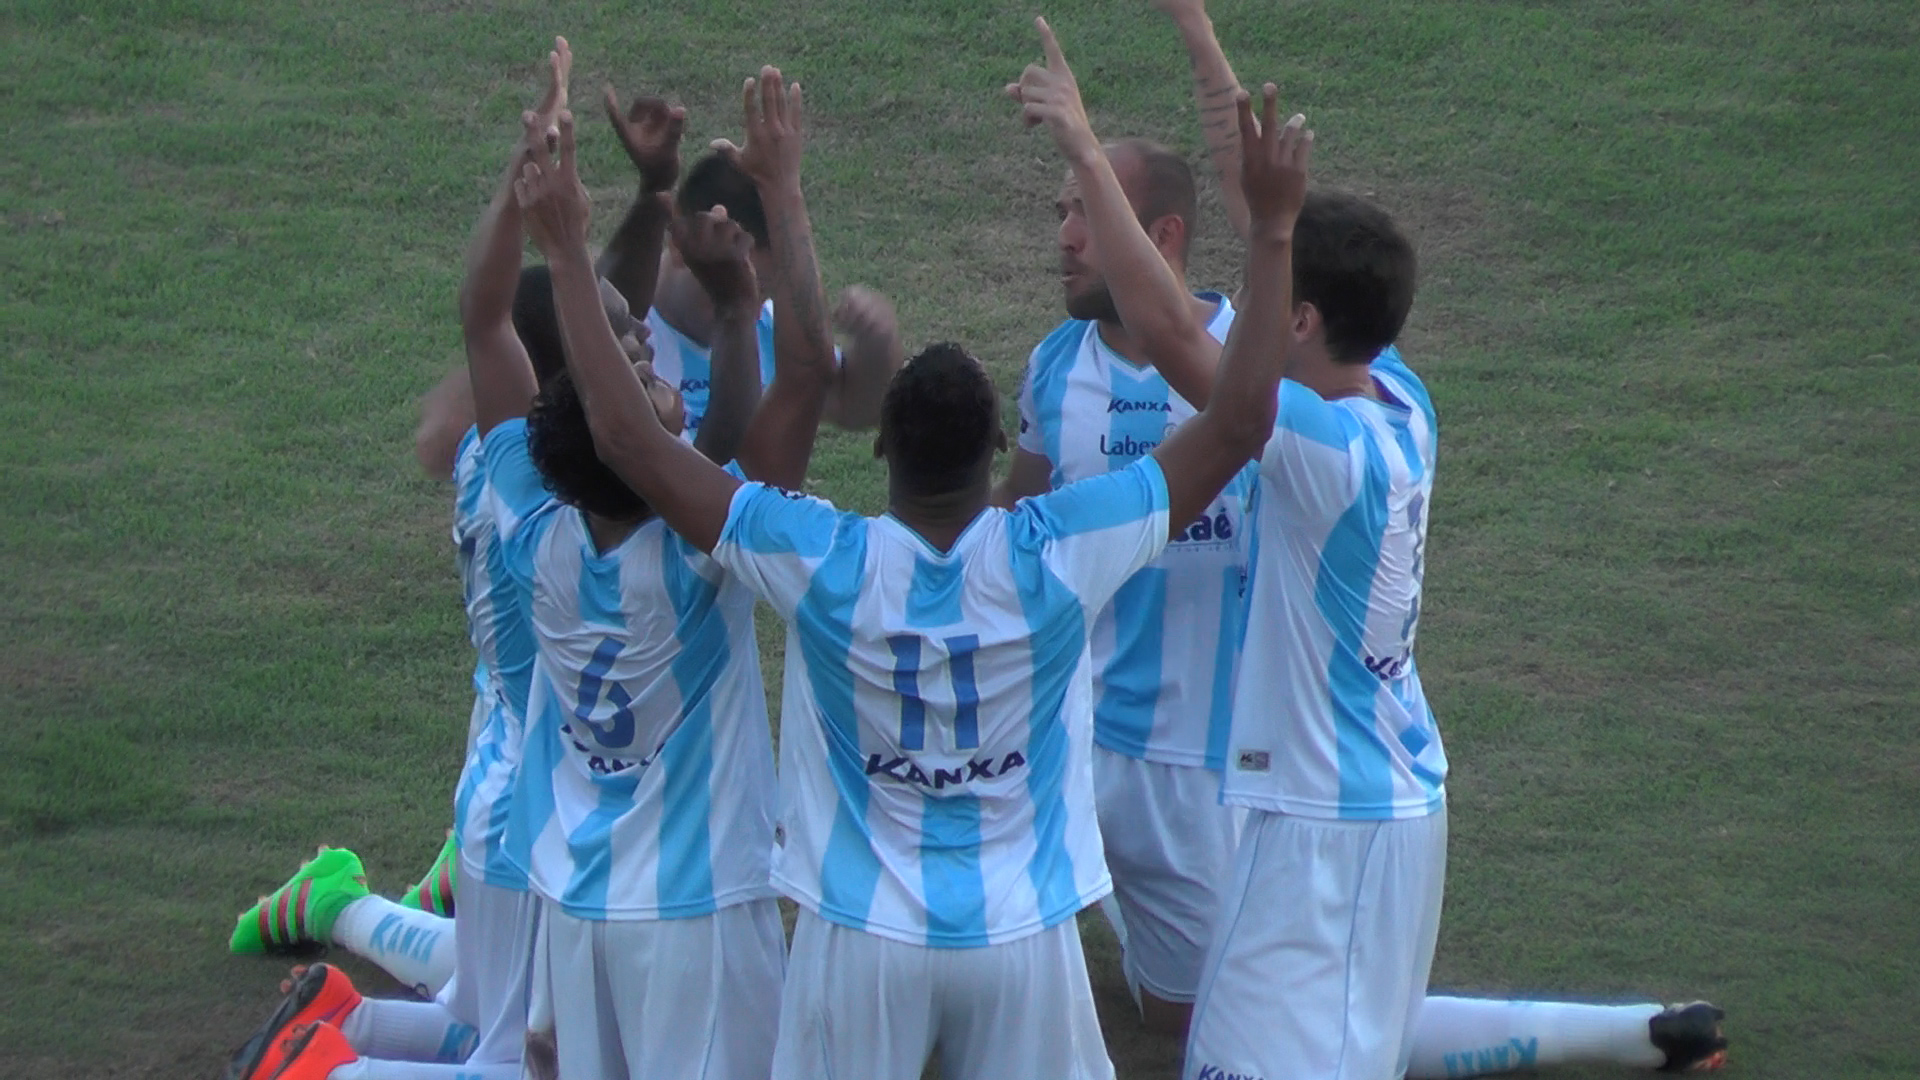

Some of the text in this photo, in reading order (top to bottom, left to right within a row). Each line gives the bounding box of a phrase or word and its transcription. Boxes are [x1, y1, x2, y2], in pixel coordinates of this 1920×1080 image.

[1107, 398, 1172, 414] KANXA
[574, 633, 636, 749] 6
[886, 633, 980, 751] 11
[865, 750, 1026, 789] KANXA
